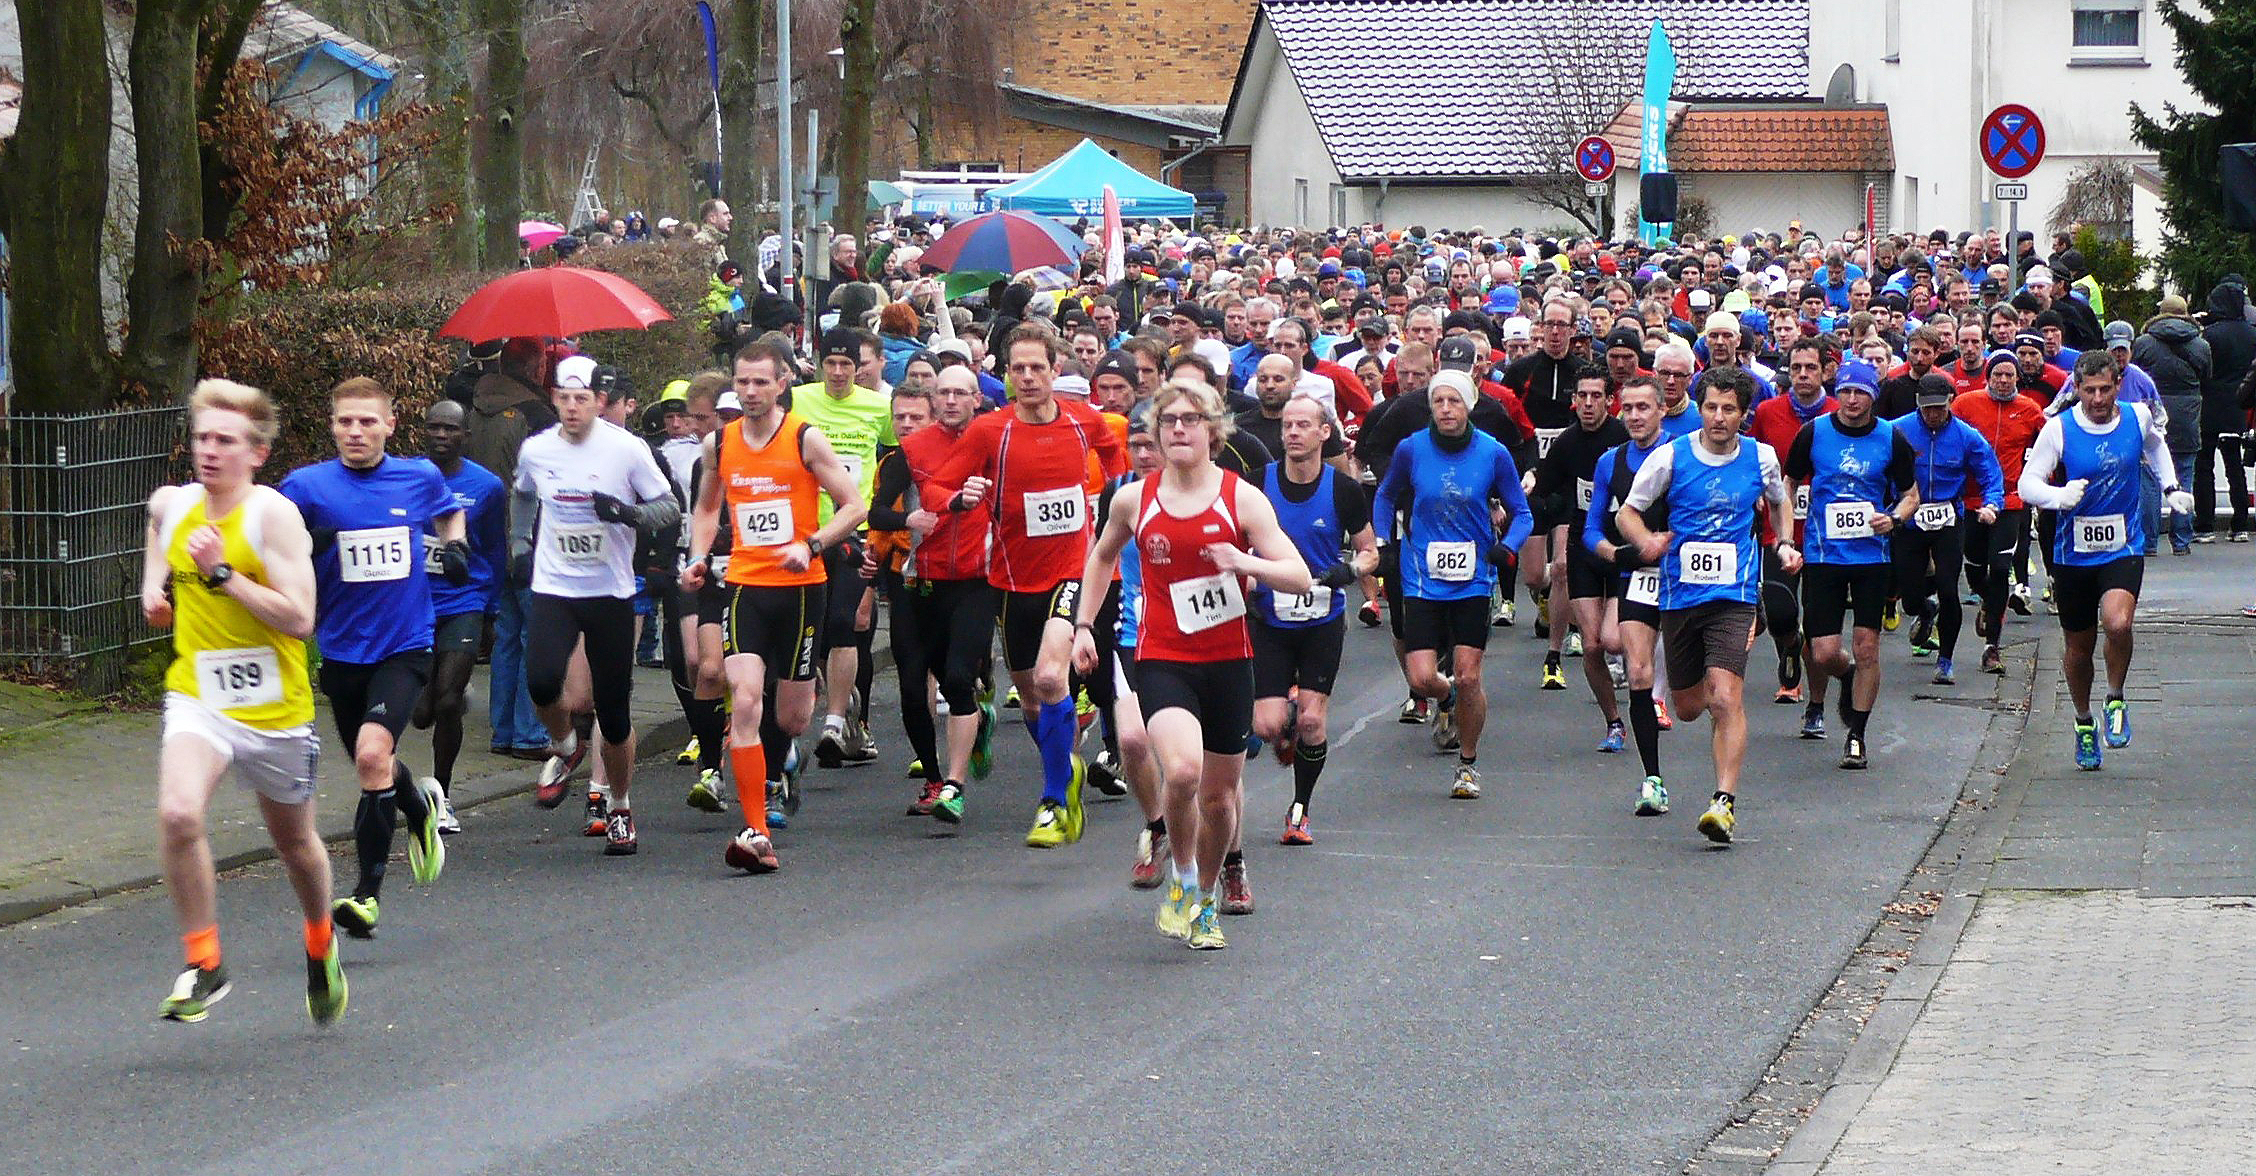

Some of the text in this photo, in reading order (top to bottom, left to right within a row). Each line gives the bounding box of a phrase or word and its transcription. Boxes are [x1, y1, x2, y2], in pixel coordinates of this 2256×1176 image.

[1038, 499, 1075, 523] 330
[1835, 511, 1865, 529] 863
[1919, 508, 1949, 524] 1041
[747, 511, 779, 533] 429
[1046, 522, 1071, 533] Oliver
[2083, 524, 2115, 542] 860
[558, 533, 603, 554] 1087
[347, 541, 402, 566] 1115
[1436, 552, 1467, 569] 862
[1690, 553, 1722, 572] 861
[1638, 575, 1660, 593] 10
[1187, 586, 1227, 616] 141
[212, 661, 263, 692] 189
